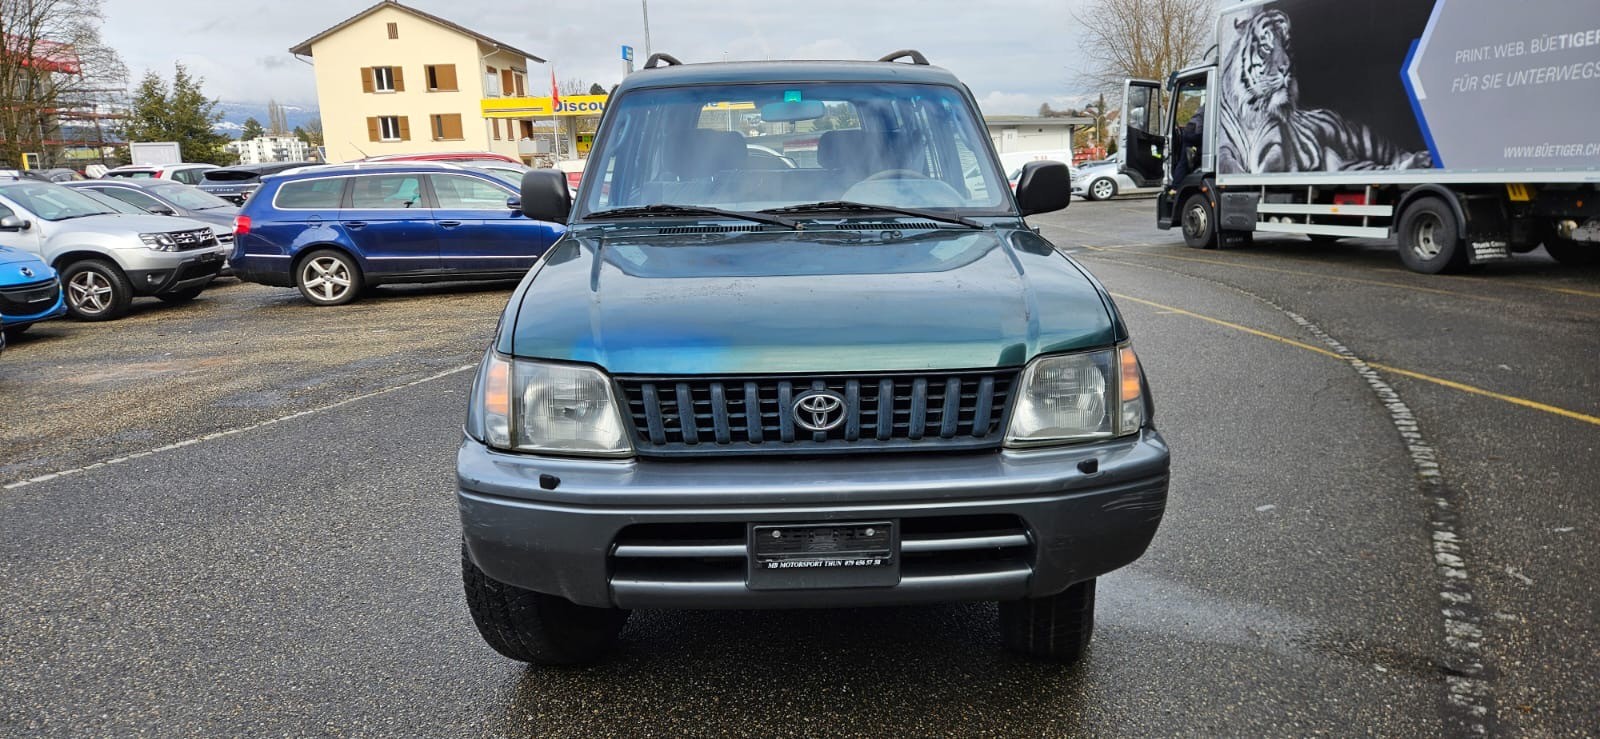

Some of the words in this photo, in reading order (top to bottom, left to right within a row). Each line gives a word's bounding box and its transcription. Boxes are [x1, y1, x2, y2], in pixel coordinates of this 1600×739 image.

[1455, 46, 1491, 63] PRINT.
[1494, 41, 1528, 58] WEB.
[1451, 74, 1478, 92] FÜR
[1481, 73, 1504, 90] SIE
